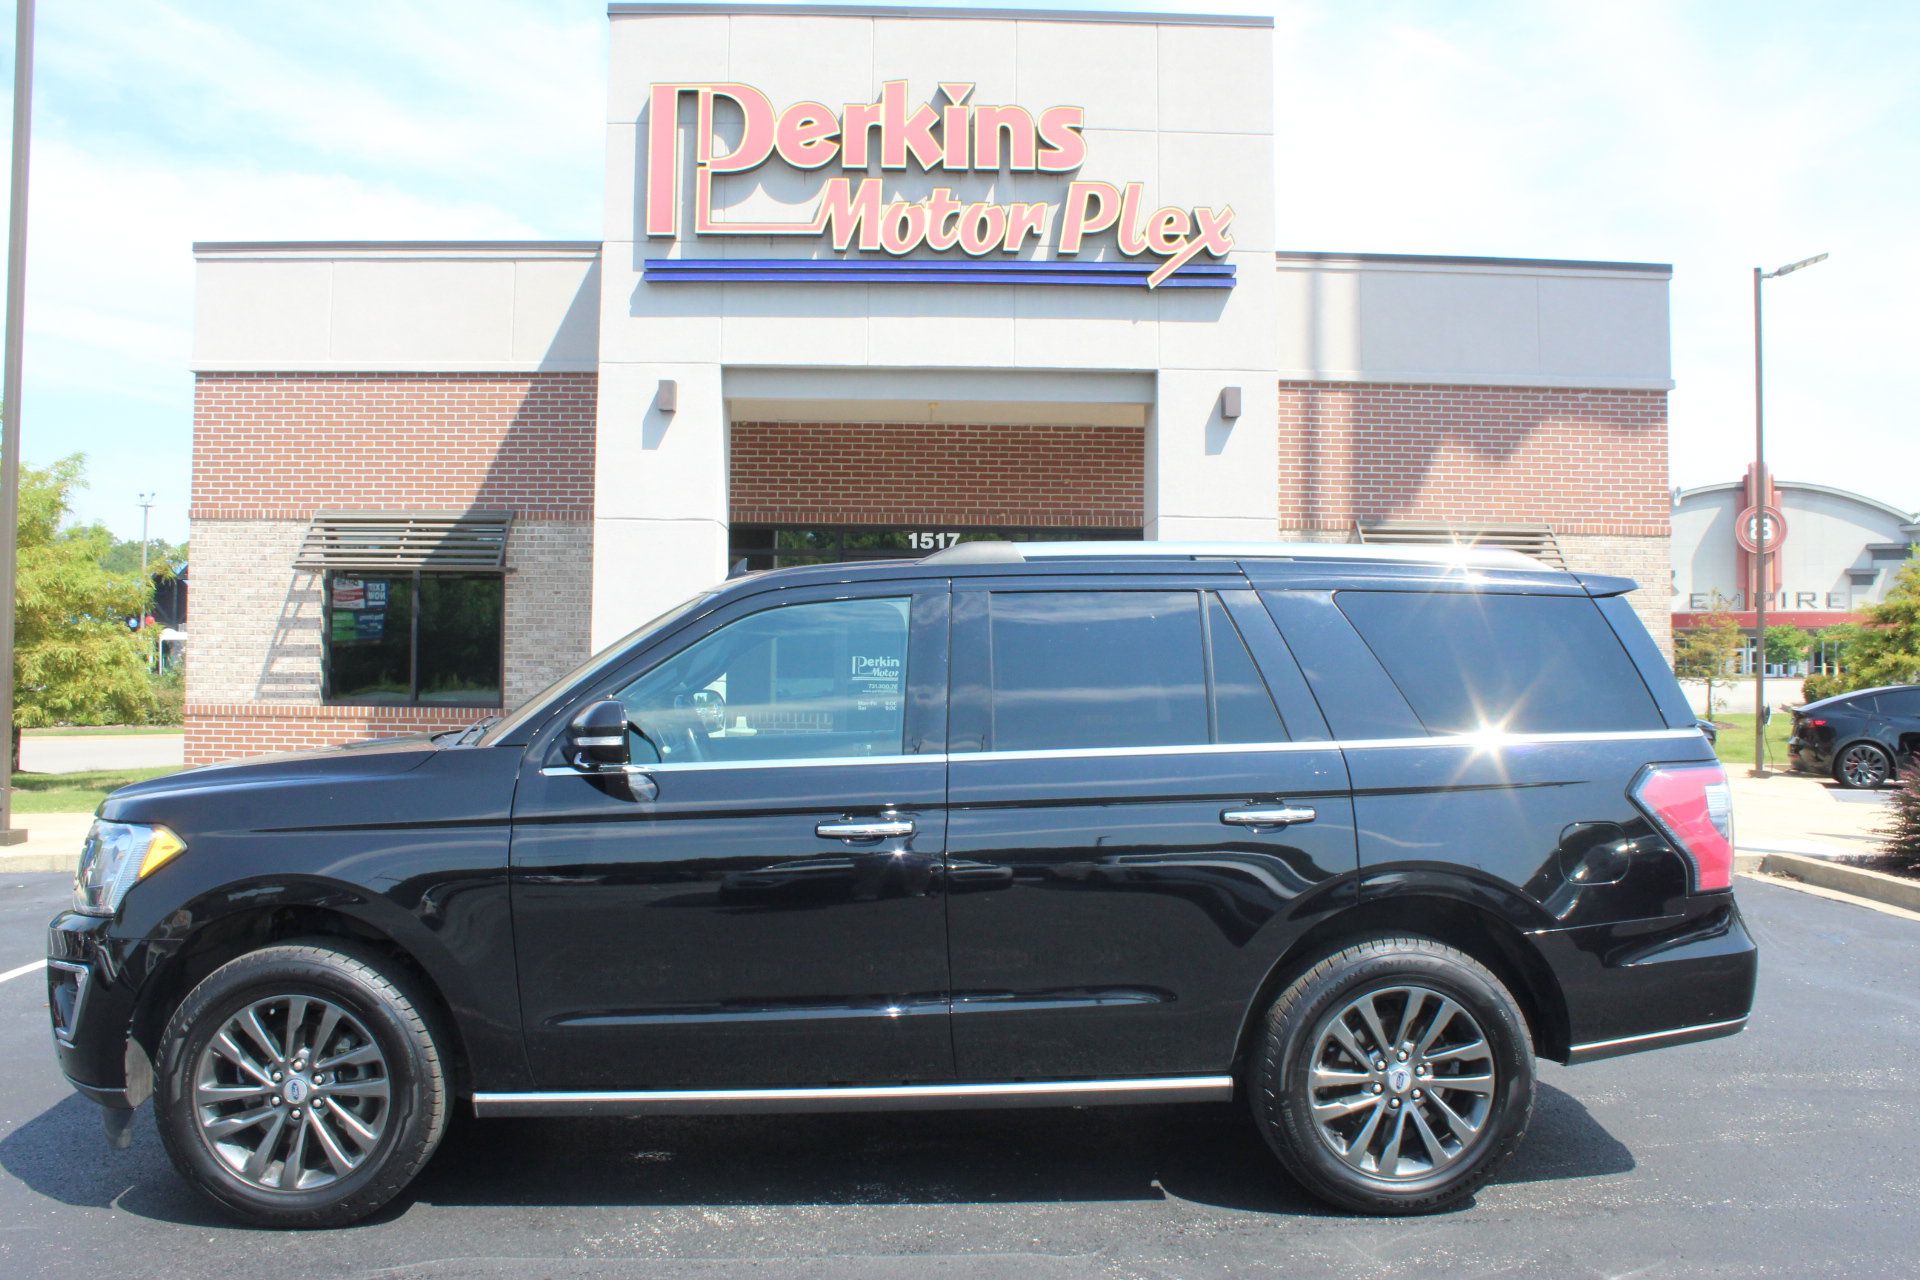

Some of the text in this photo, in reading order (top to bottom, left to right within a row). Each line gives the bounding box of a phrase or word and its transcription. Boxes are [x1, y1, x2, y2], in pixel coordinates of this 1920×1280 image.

[647, 80, 1088, 238] Perkins
[818, 177, 1236, 289] Motor Plex
[908, 532, 960, 549] 1517
